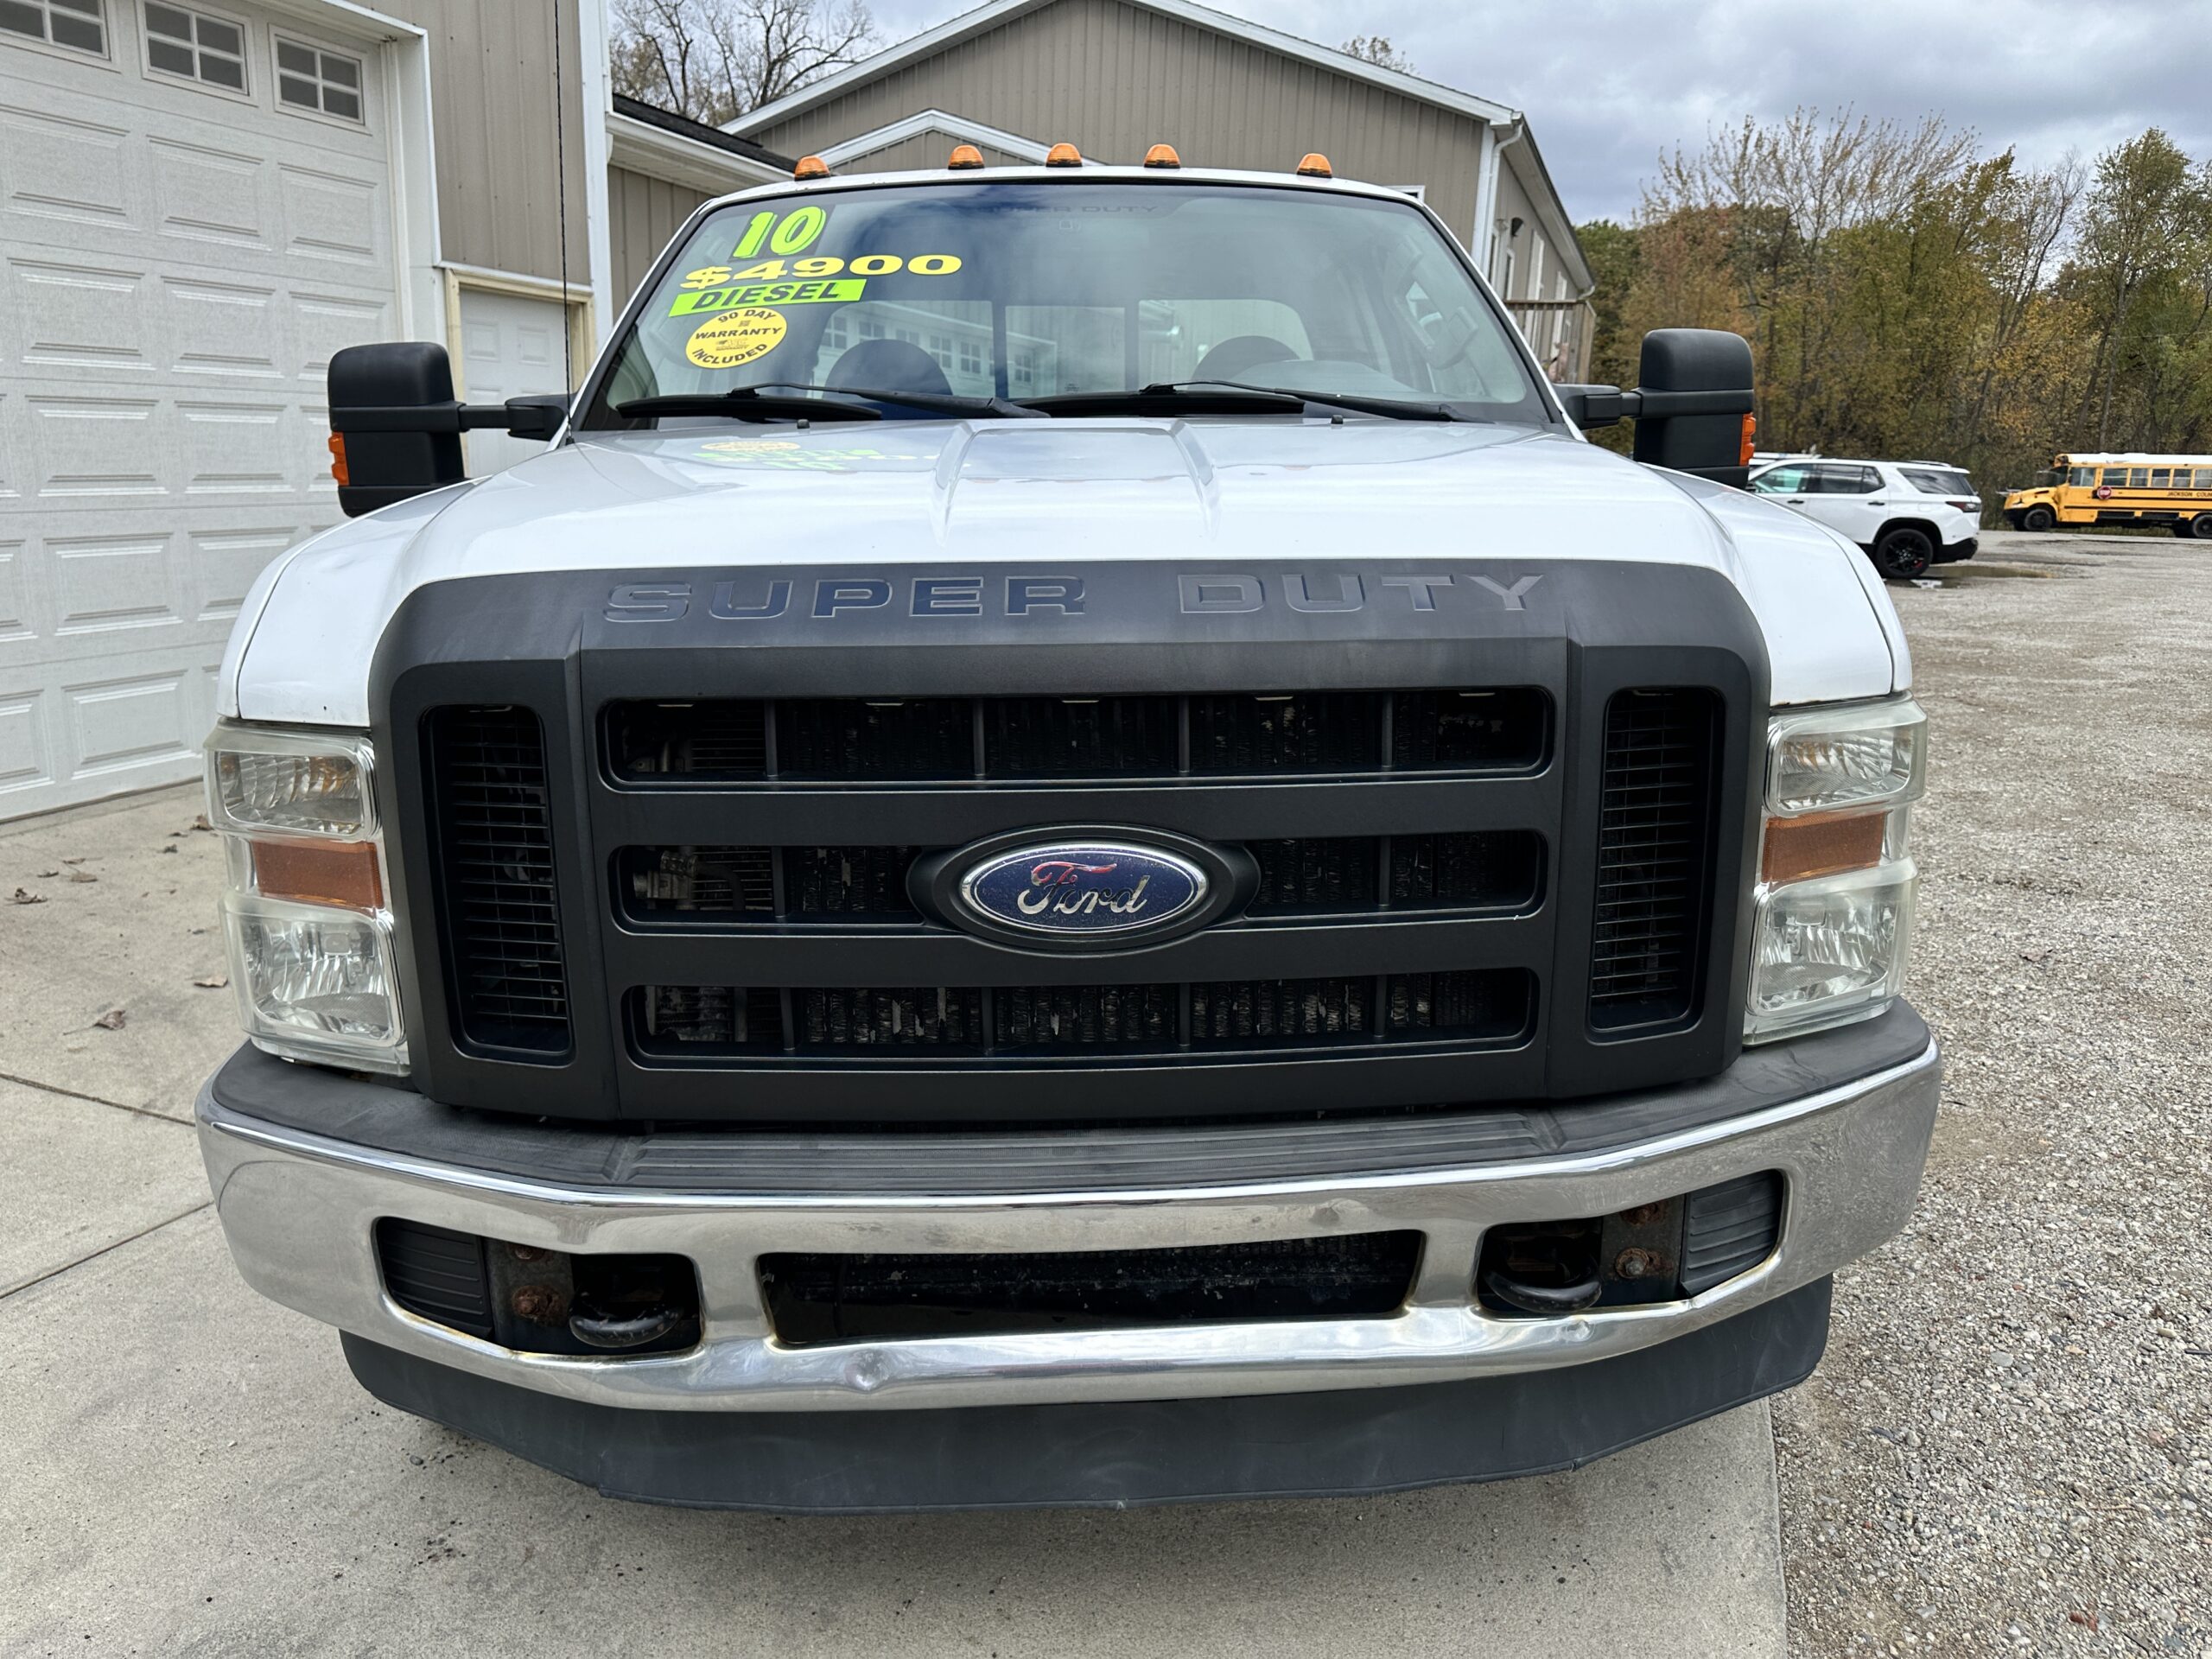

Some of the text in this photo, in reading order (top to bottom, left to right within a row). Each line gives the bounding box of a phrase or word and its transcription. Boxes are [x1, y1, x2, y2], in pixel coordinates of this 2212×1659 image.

[732, 206, 827, 258] 10
[679, 254, 963, 289] $4900
[691, 282, 842, 309] DIESEL
[718, 309, 776, 322] 90 DAY
[695, 327, 783, 340] WARRANTY
[692, 344, 767, 364] INCLUDED
[603, 573, 1544, 623] SUPER DUTY
[1017, 861, 1151, 915] Ford
